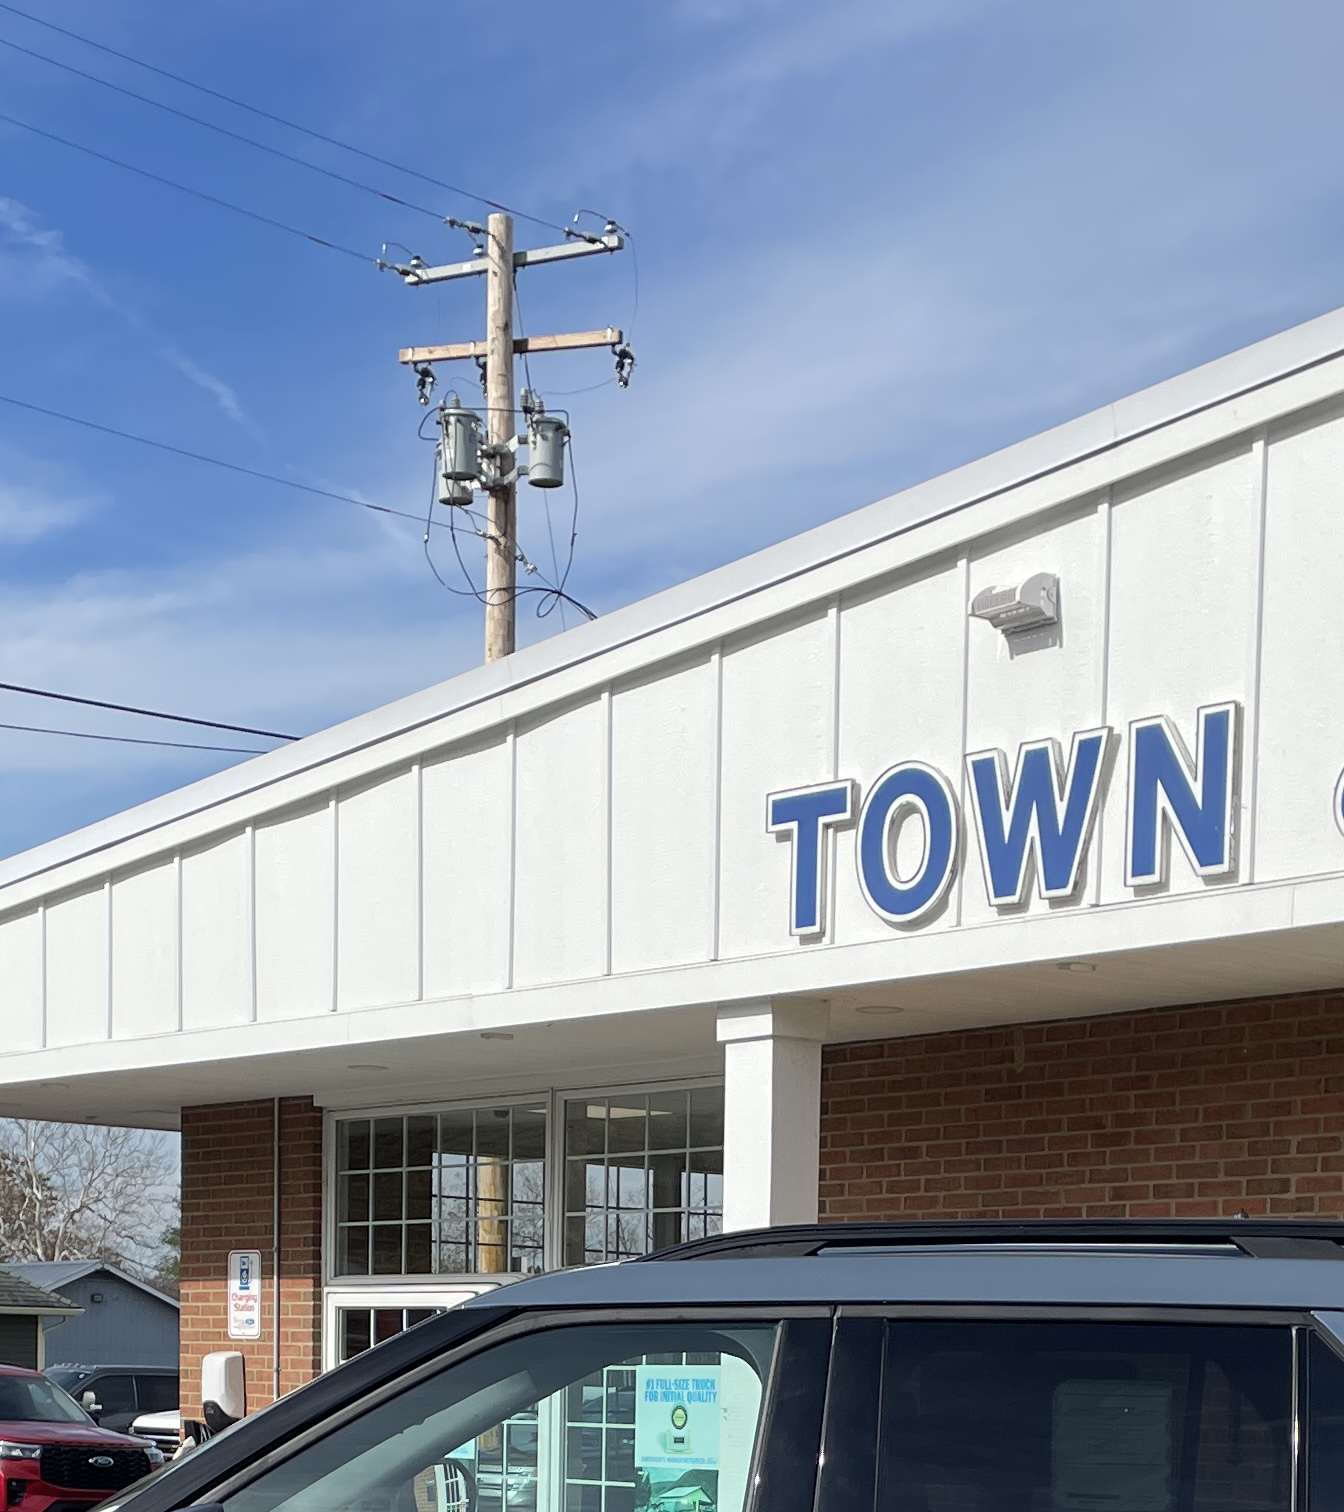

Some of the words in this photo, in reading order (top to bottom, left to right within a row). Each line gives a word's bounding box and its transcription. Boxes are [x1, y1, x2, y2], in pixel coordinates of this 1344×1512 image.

[766, 701, 1241, 936] TOWN
[232, 1293, 257, 1303] Charging
[234, 1303, 254, 1312] Station
[655, 1379, 689, 1390] FULL-SIZE
[692, 1379, 716, 1390] TRUCK
[645, 1391, 658, 1402] FOR
[660, 1391, 685, 1402] INITIAL
[687, 1391, 718, 1404] QUALITY
